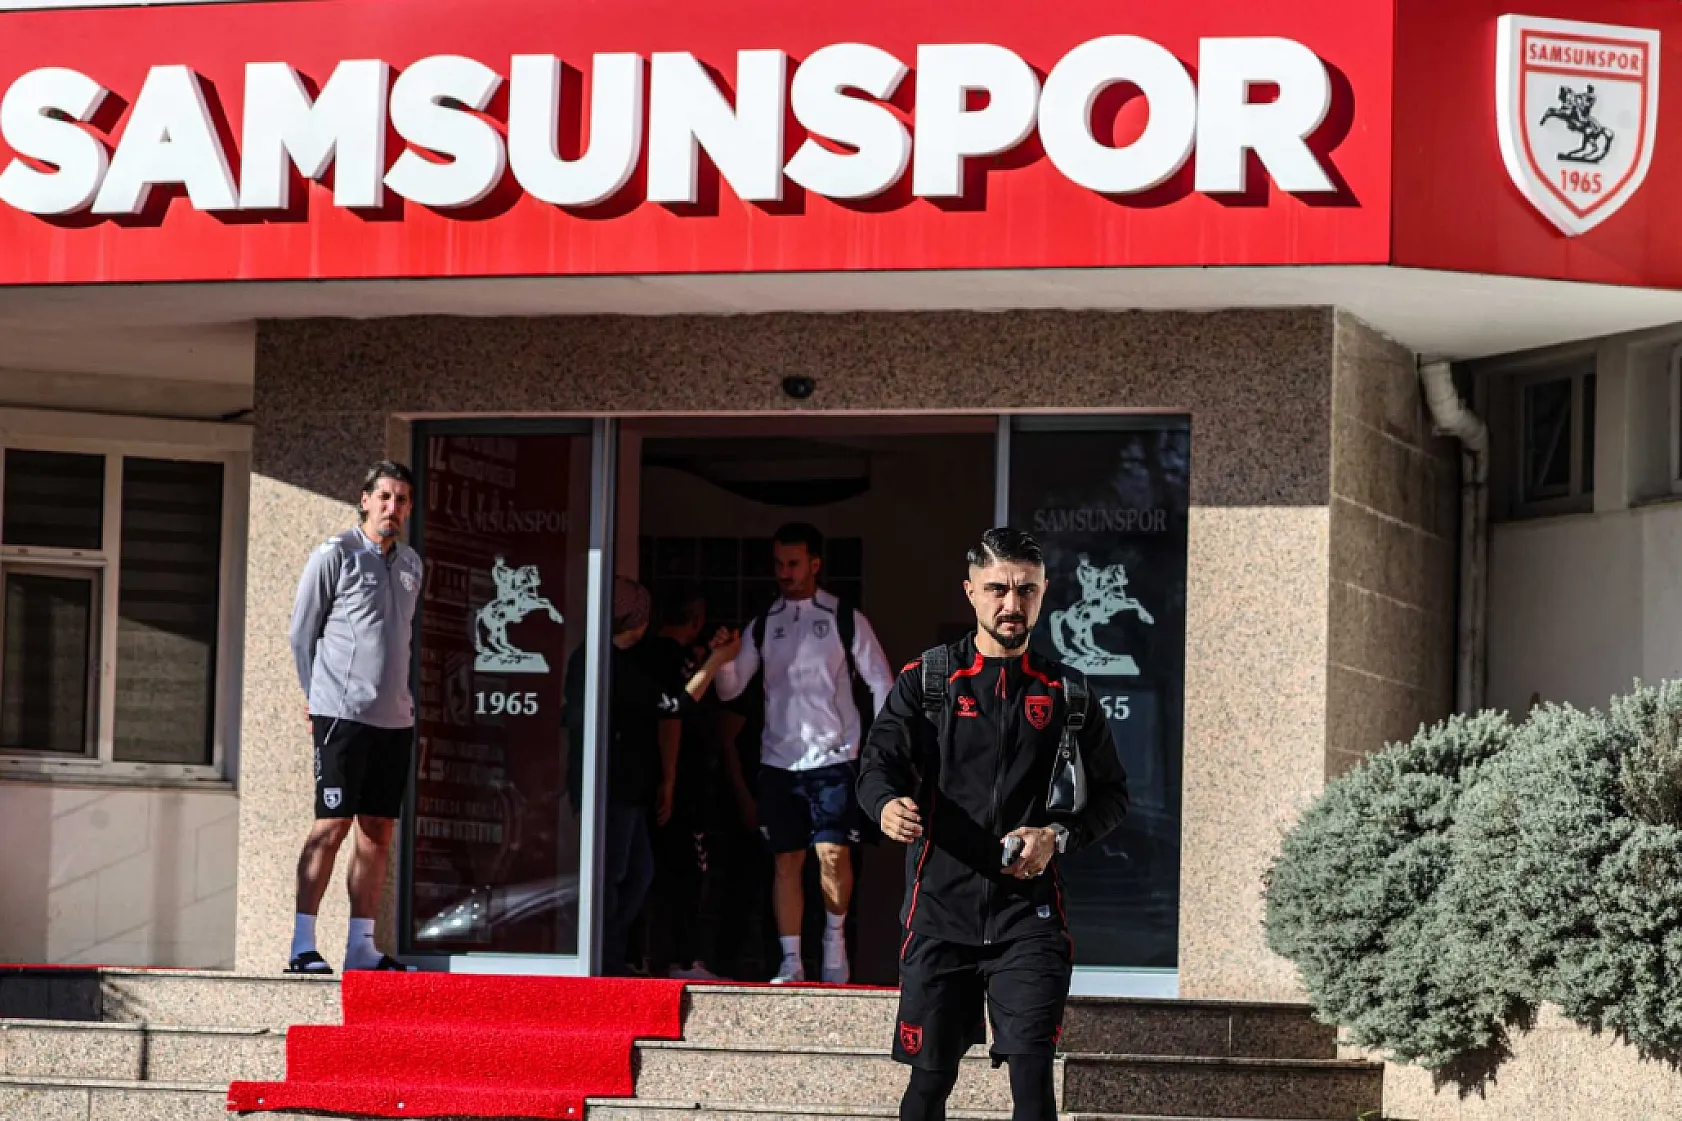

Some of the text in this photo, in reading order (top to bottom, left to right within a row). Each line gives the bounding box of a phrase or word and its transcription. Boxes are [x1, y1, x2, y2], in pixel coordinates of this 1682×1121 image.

[1529, 42, 1640, 71] SAMSUNSPOR
[0, 34, 1337, 215] SAMSUNSPOR
[1560, 169, 1603, 194] 1965
[1033, 508, 1167, 532] SAMSUNSPOR
[474, 691, 539, 716] 1965
[1100, 696, 1131, 720] 65
